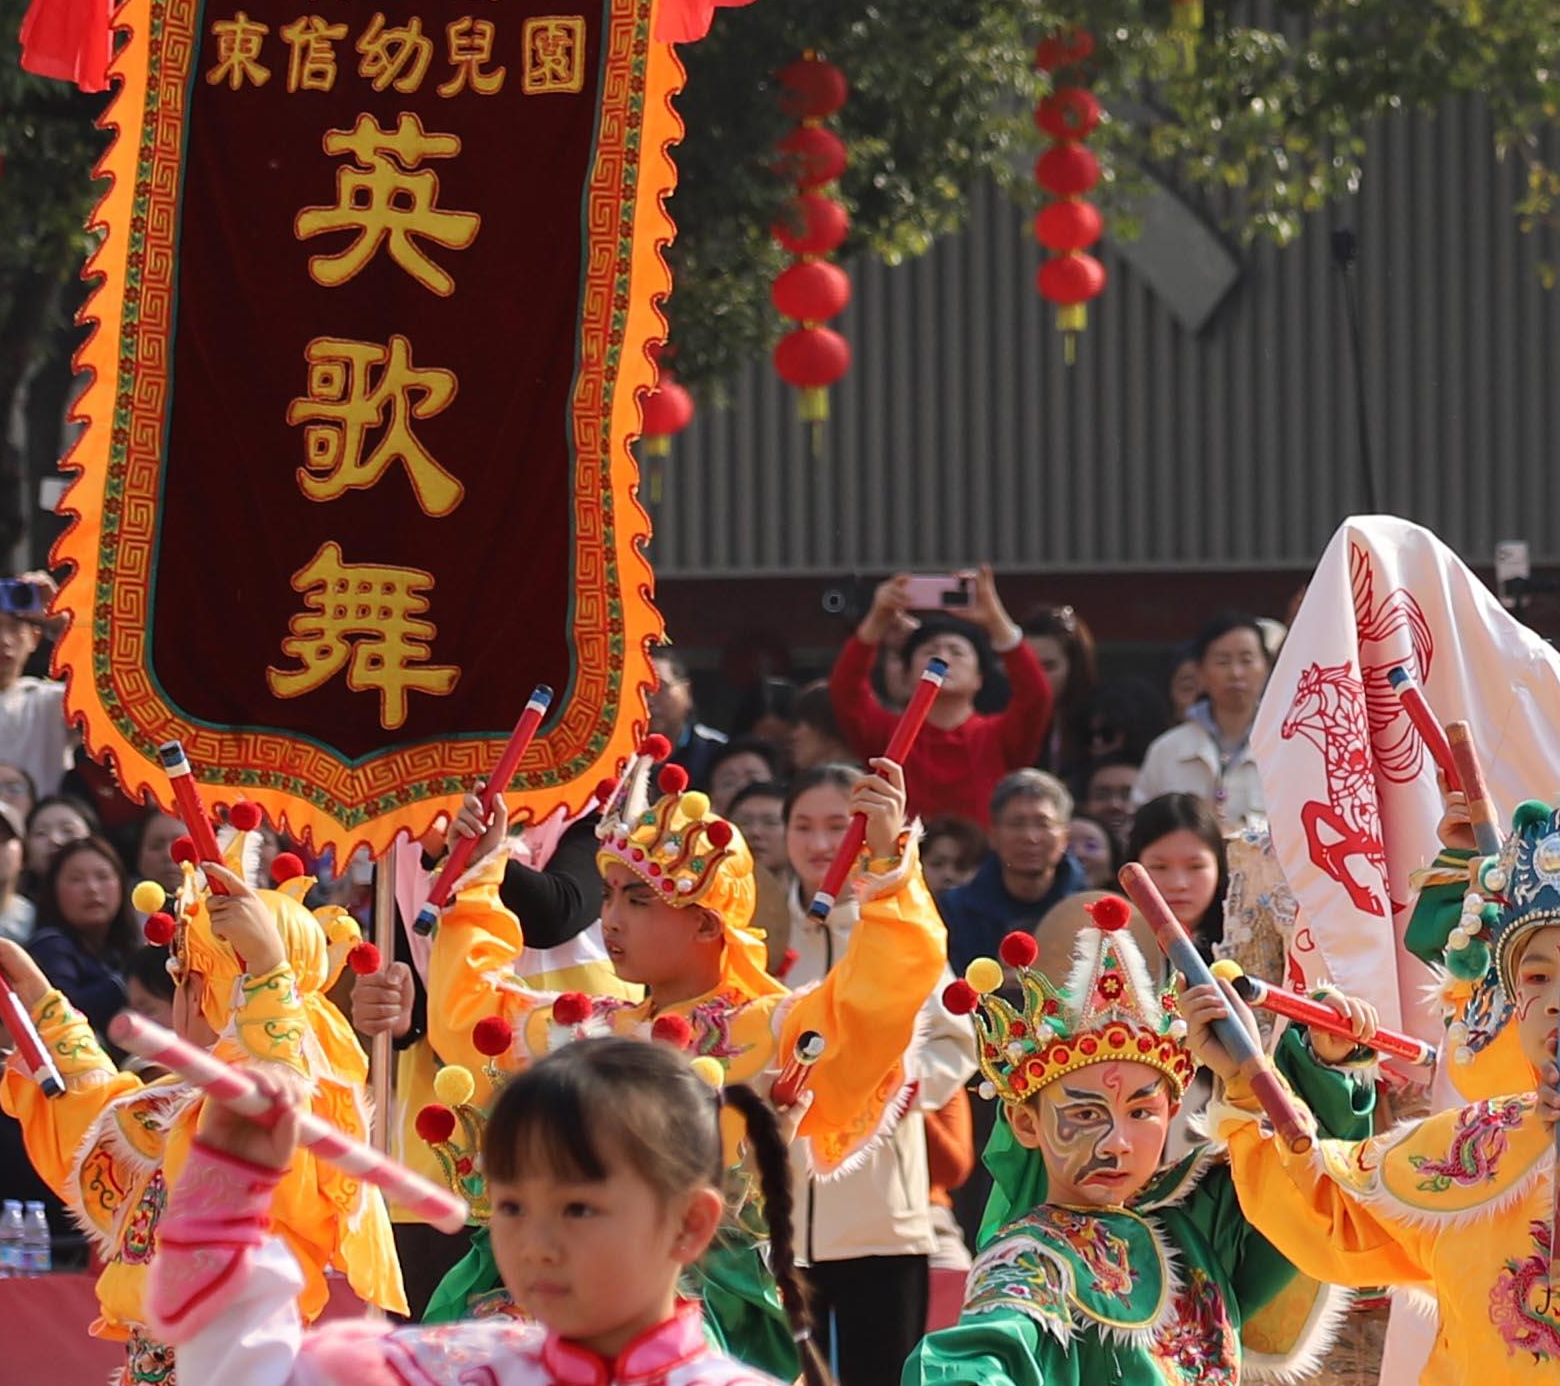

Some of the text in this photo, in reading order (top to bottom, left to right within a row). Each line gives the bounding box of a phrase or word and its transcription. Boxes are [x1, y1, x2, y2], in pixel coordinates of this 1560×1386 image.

[205, 11, 587, 99] 東信幼兒園
[266, 110, 482, 732] 英歌舞
